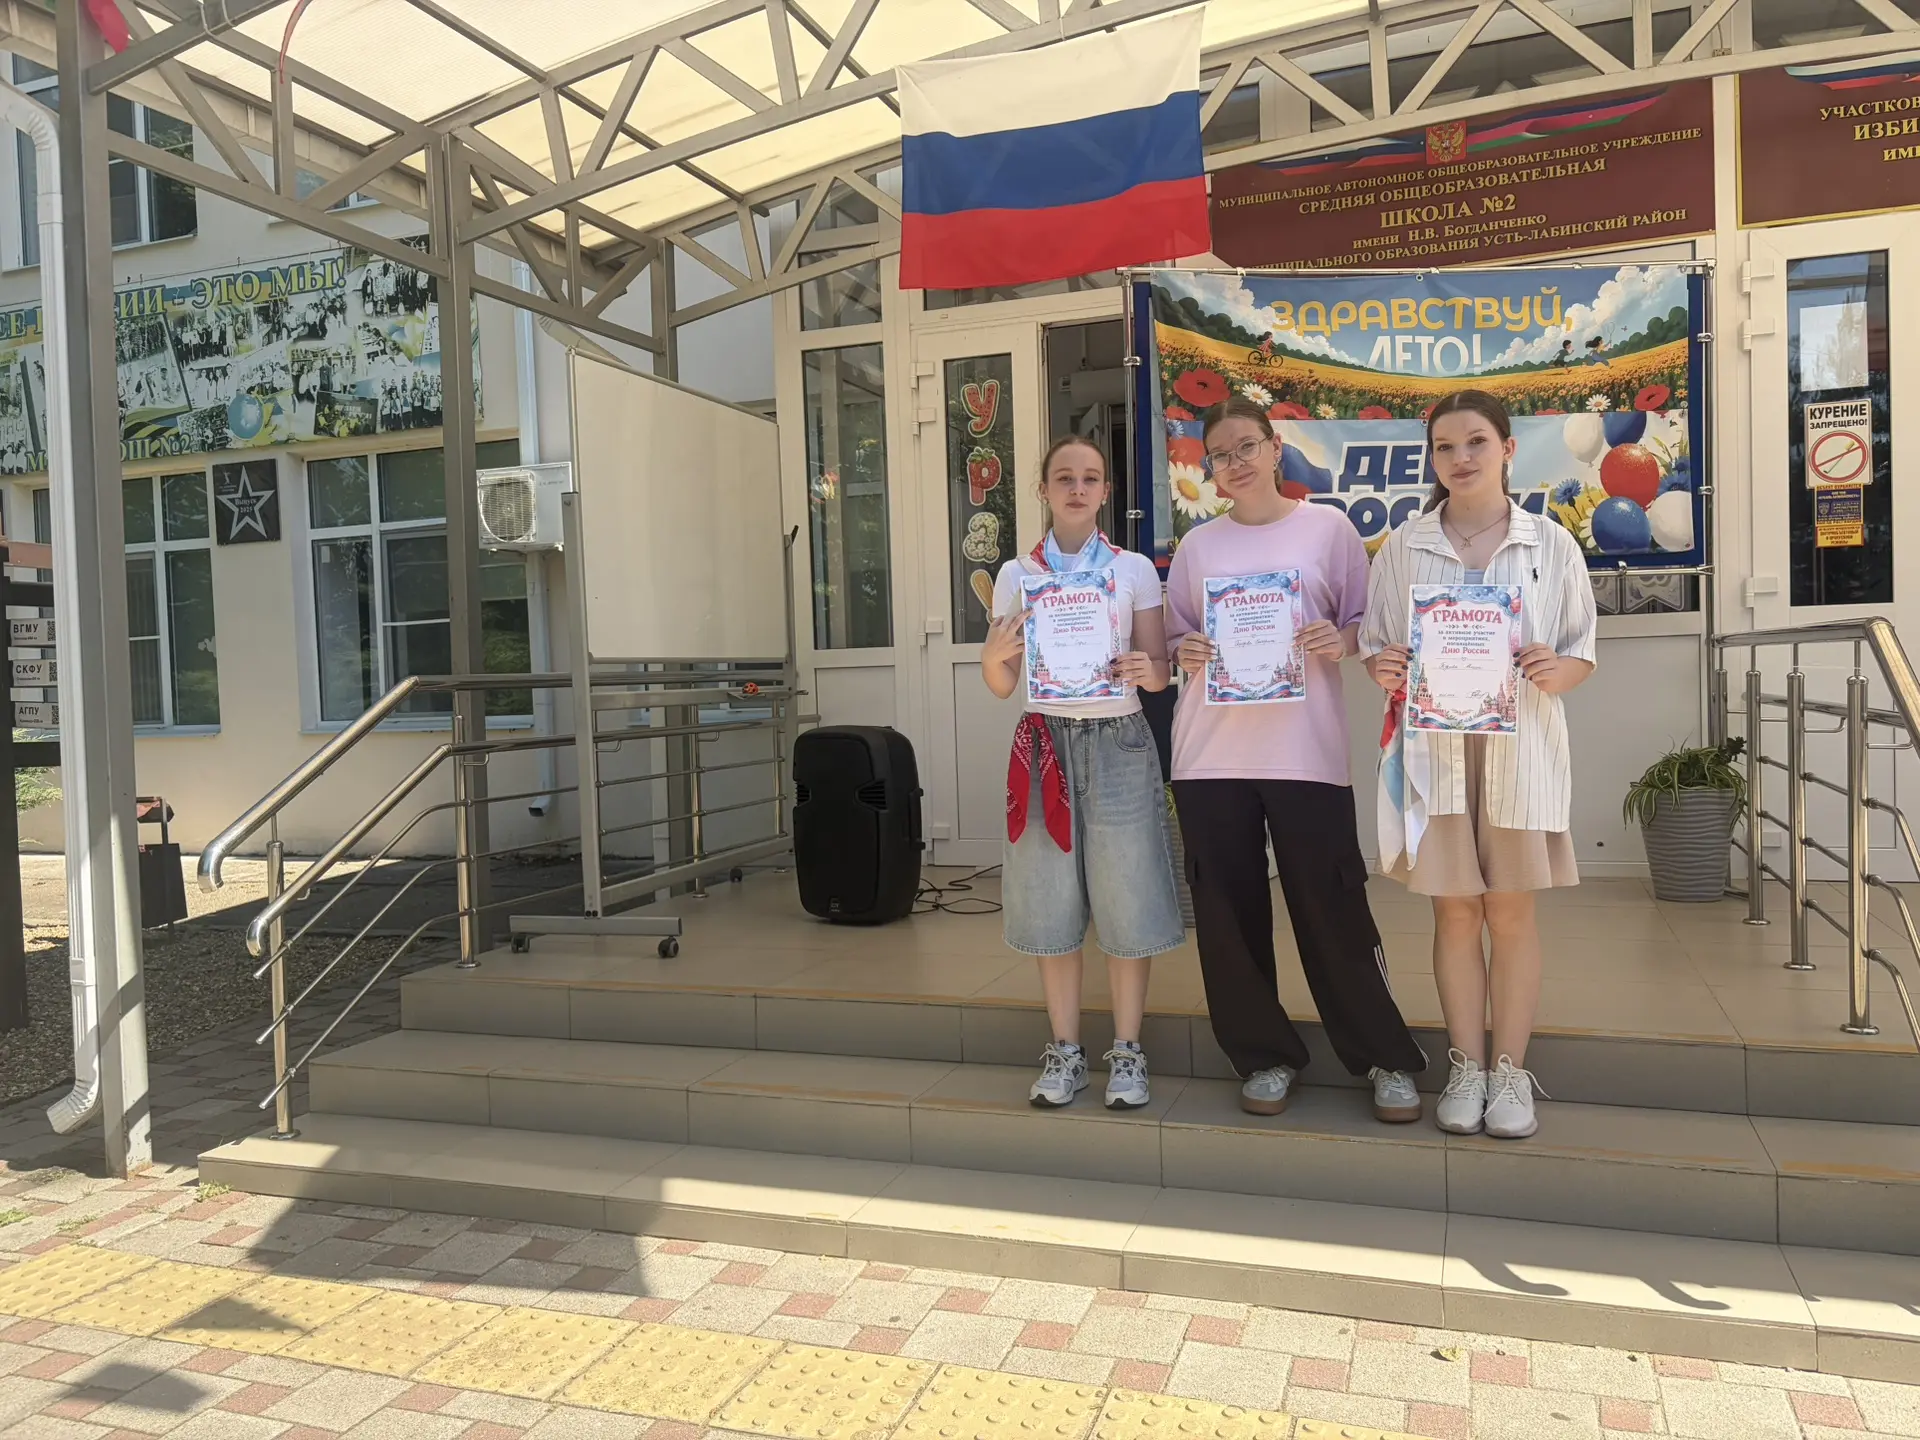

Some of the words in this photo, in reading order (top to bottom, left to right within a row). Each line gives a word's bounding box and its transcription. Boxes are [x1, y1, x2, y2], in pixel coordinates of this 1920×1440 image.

[1853, 117, 1920, 141] ИЗБИ
[1219, 183, 1331, 209] МУНИЦИПАЛЬНОЕ
[1334, 171, 1425, 193] АВТОНОМНОЕ
[1427, 143, 1599, 180] ОБЩЕОБРАЗОВАТЕЛЬНОЕ
[1602, 127, 1702, 152] УЧРЕЖДЕНИЕ
[1298, 192, 1376, 215] СРЕДНЯЯ
[1379, 157, 1607, 204] ОБЩЕОБРАЗОВАТЕЛЬНАЯ
[1379, 201, 1473, 229] ШКОЛА
[1479, 193, 1517, 216] №2
[1375, 235, 1480, 261] ОБРАЗОВАНИЯ
[1484, 215, 1629, 247] УСТЬ-ЛАБИНСКИЙ
[1631, 208, 1687, 227] РАЙОН
[1407, 228, 1440, 243] Н.В.
[190, 271, 262, 309] ЭТО
[267, 256, 347, 299] МЫ!
[1269, 286, 1573, 337] ЗДРАВСТВУЙ,
[1365, 333, 1483, 377] ЛЕТО!
[1809, 403, 1867, 421] КУРЕНИЕ
[1809, 418, 1868, 430] ЗАПРЕЩЕНО!
[1042, 592, 1102, 609] ГРАМОТА
[1224, 592, 1285, 609] ГРАМОТА
[1432, 609, 1503, 624] ГРАМОТА
[13, 623, 39, 634] ВГМУ
[1070, 625, 1094, 633] России
[1251, 624, 1276, 632] России
[1441, 646, 1460, 654] Дню
[1462, 646, 1490, 654] России
[15, 664, 42, 674] СКФУ
[18, 706, 40, 716] АГПУ
